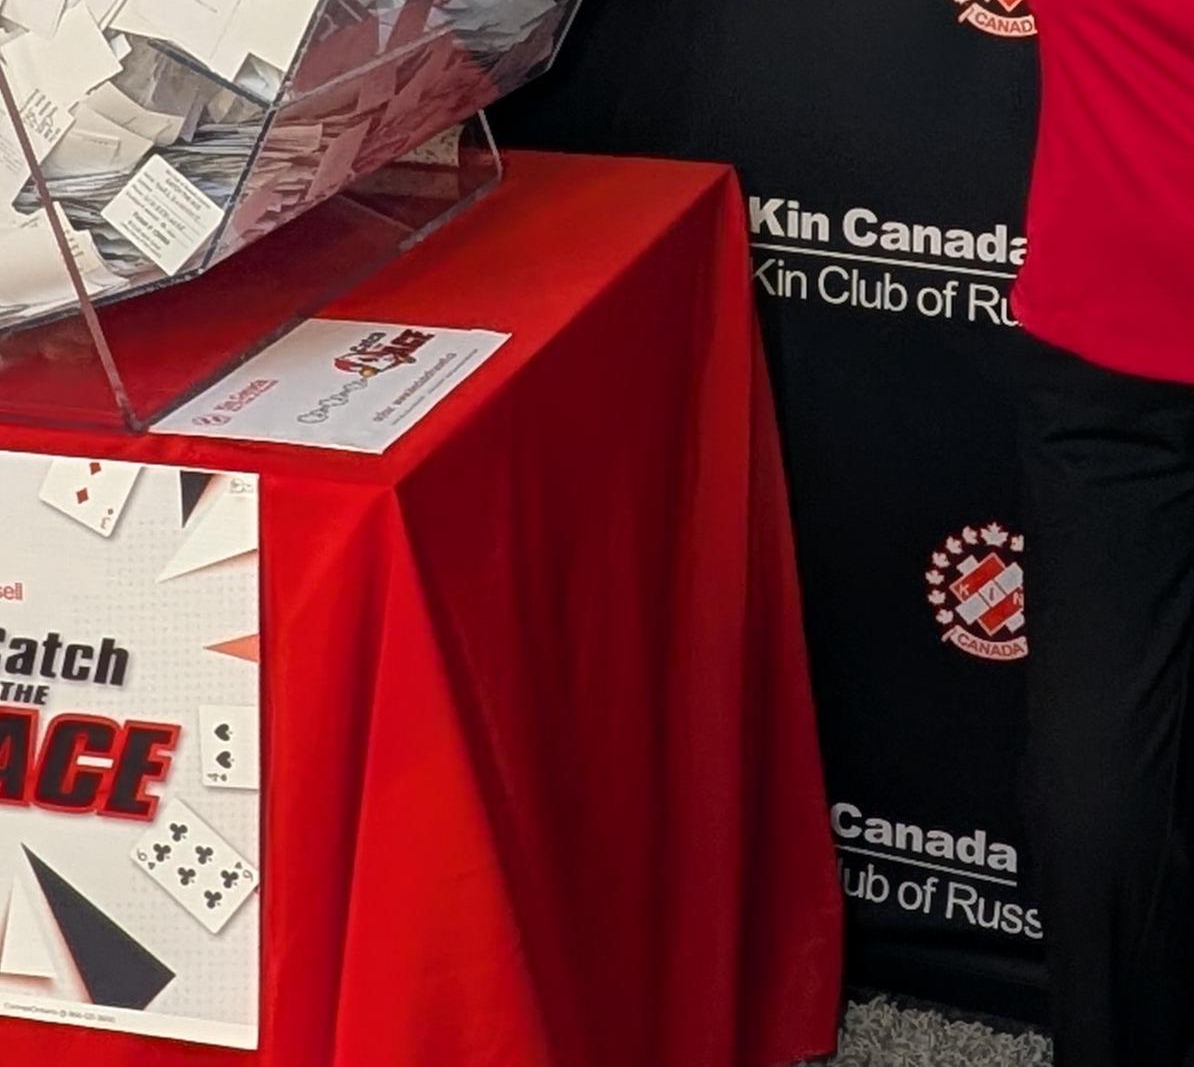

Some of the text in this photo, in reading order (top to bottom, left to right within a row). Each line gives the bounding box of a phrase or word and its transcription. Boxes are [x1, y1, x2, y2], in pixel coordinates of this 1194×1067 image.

[975, 12, 1033, 34] CANAD
[749, 196, 1028, 266] Kin Canada
[752, 257, 807, 300] Kin
[818, 265, 908, 313] Club
[916, 280, 959, 319] of
[0, 626, 130, 686] atch
[957, 633, 1025, 657] CANADA
[0, 681, 50, 705] THE
[831, 802, 1018, 874] Canada
[837, 858, 1044, 939] lub of Russ
